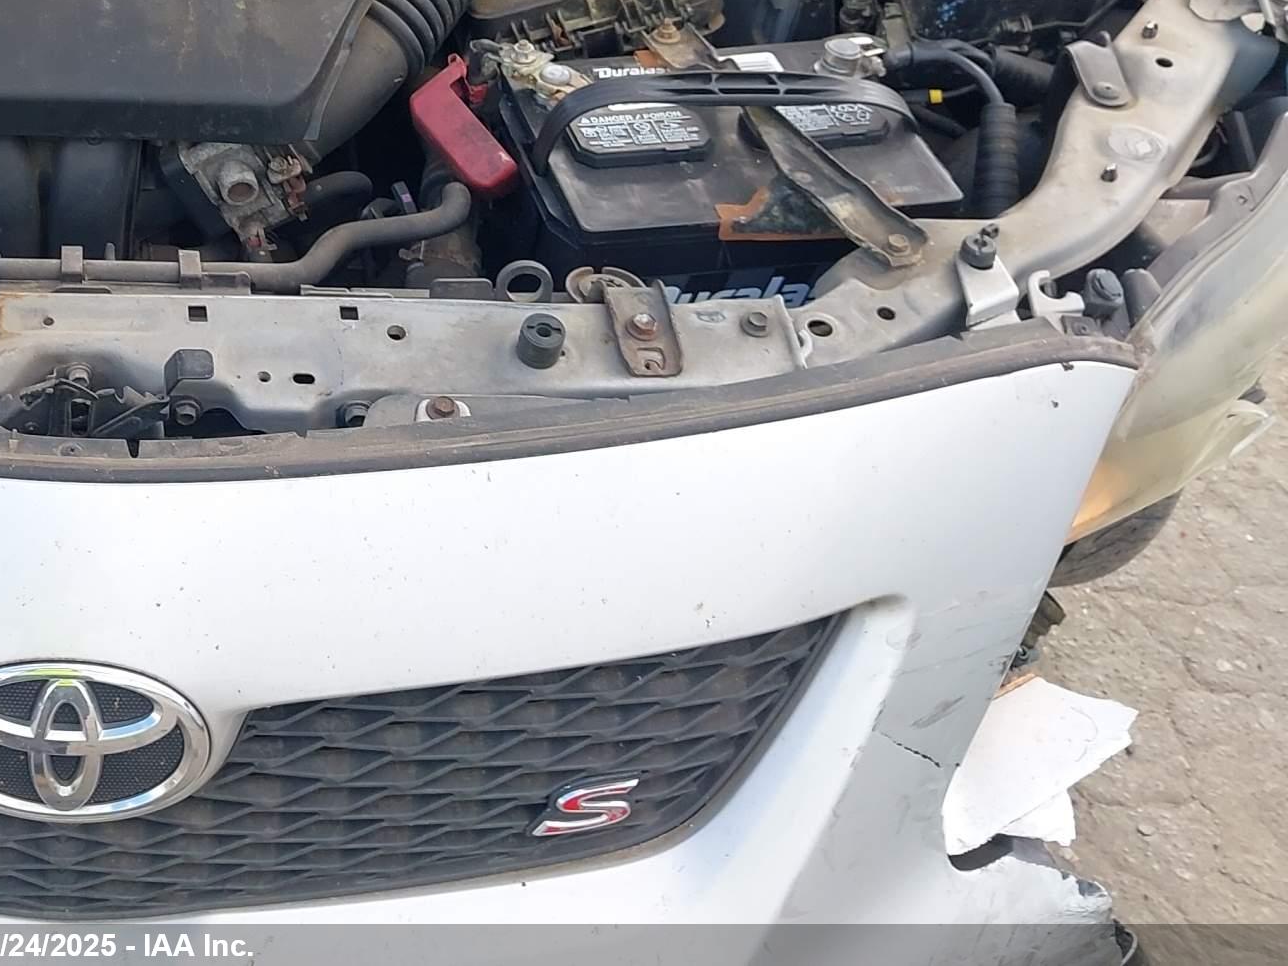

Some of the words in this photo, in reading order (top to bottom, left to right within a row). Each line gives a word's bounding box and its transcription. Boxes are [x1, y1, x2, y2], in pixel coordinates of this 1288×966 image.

[593, 65, 673, 78] Duralas
[590, 114, 634, 124] DANGER
[532, 778, 639, 836] S
